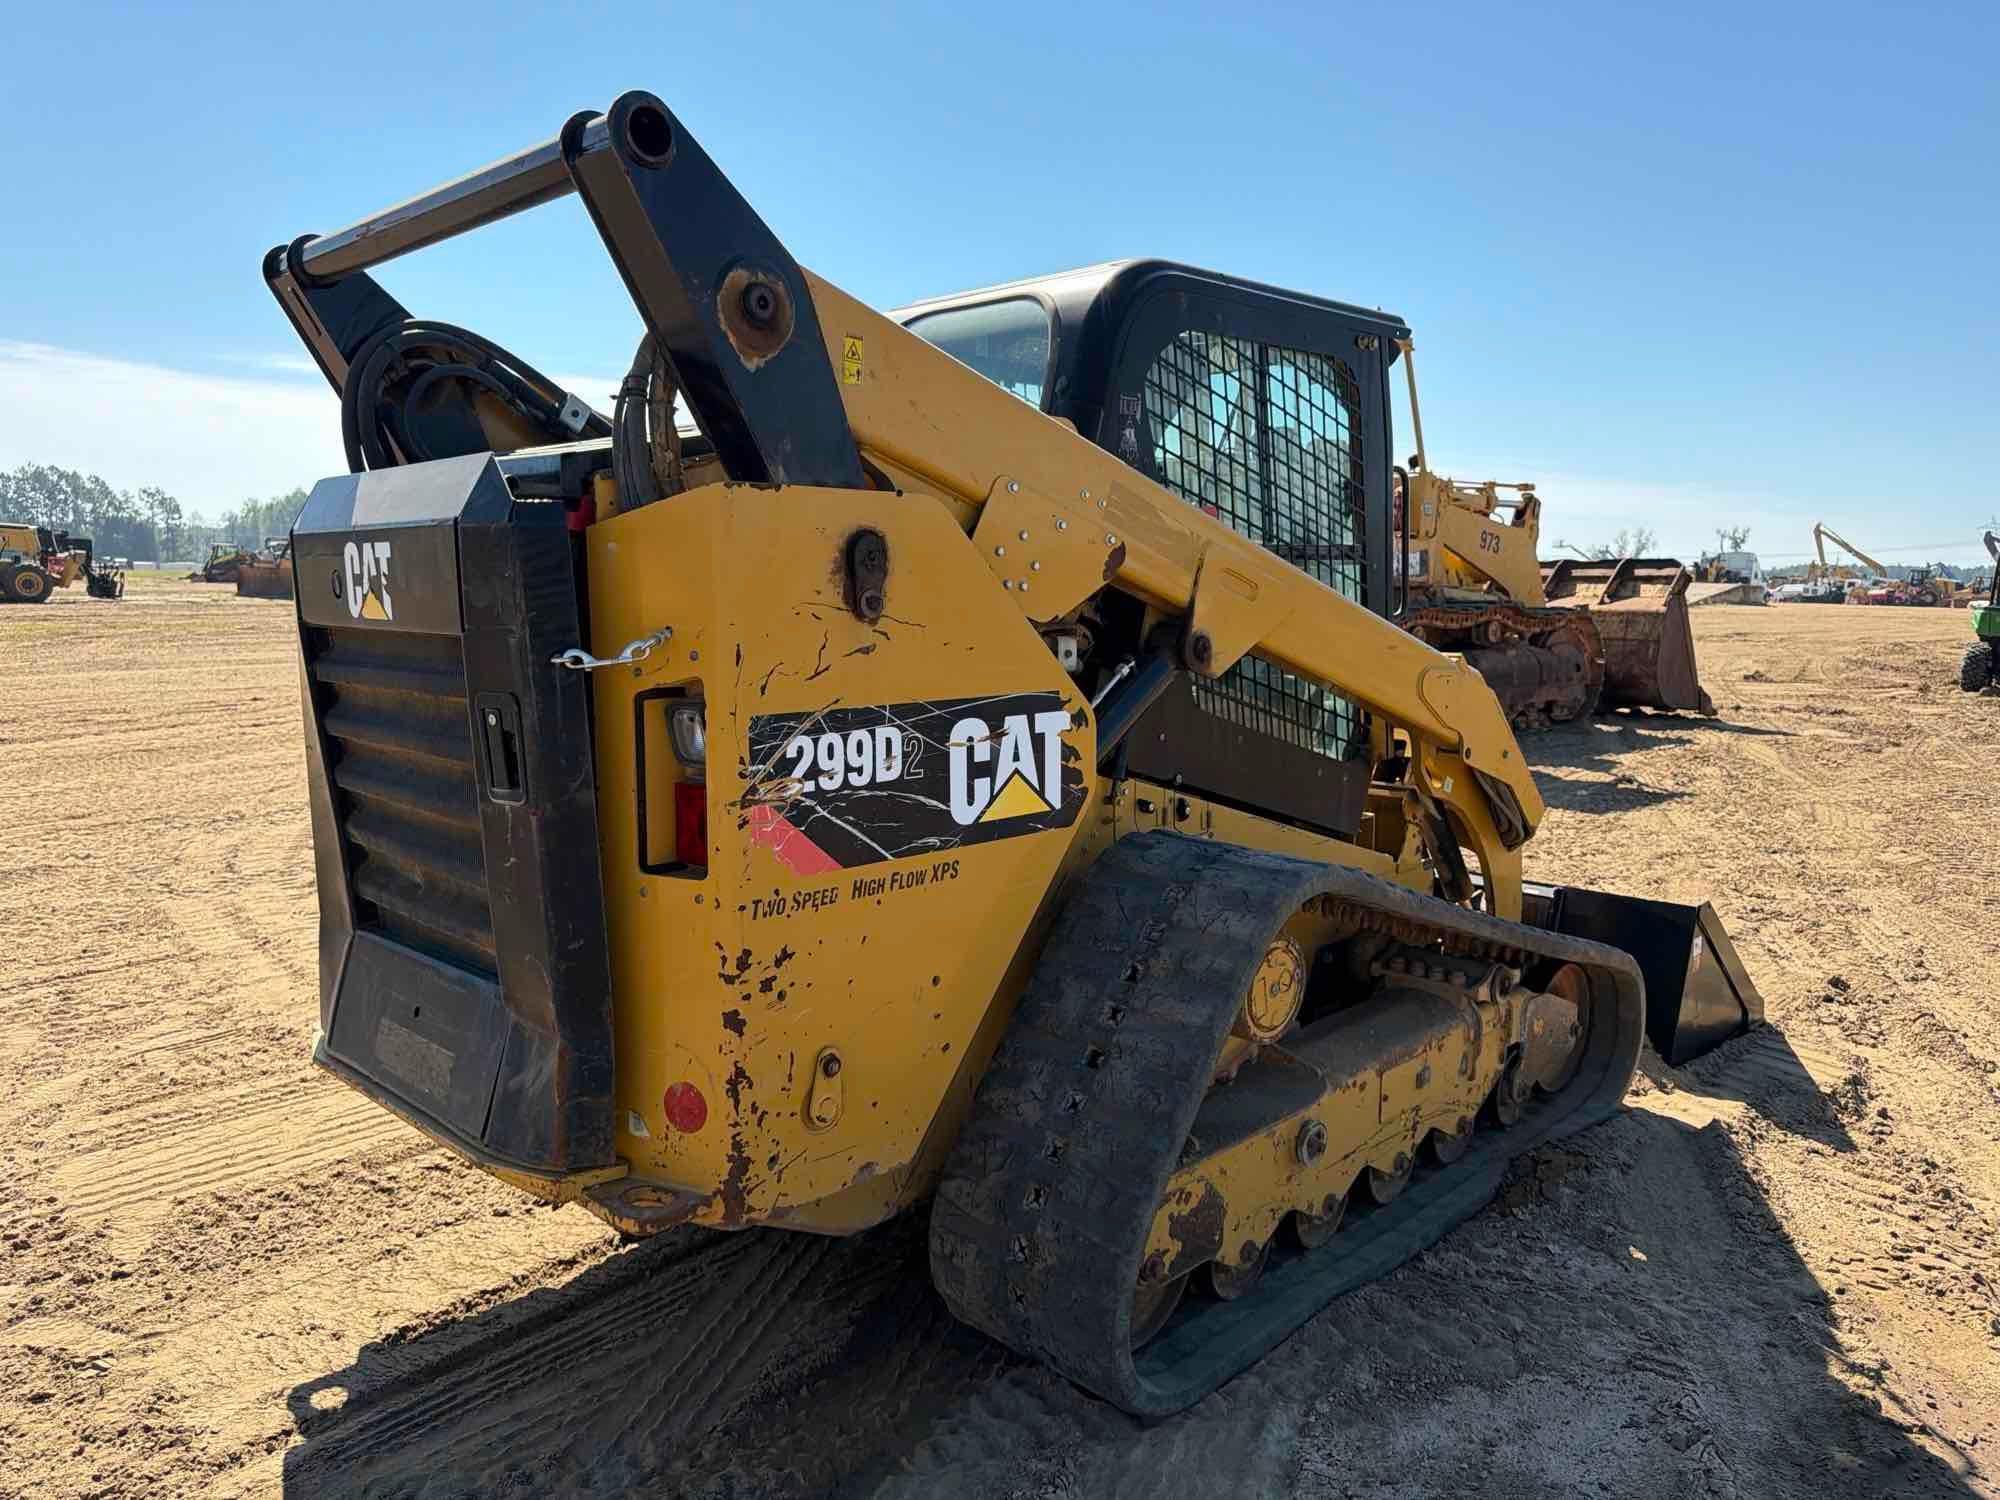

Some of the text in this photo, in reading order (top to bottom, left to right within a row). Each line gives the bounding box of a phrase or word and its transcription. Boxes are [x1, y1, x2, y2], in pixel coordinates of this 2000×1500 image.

[1479, 530, 1501, 554] 973
[343, 541, 393, 621] CAT
[949, 710, 1073, 826] CAT
[751, 860, 960, 921] TWO SPEED HIGH FLOW XPS
